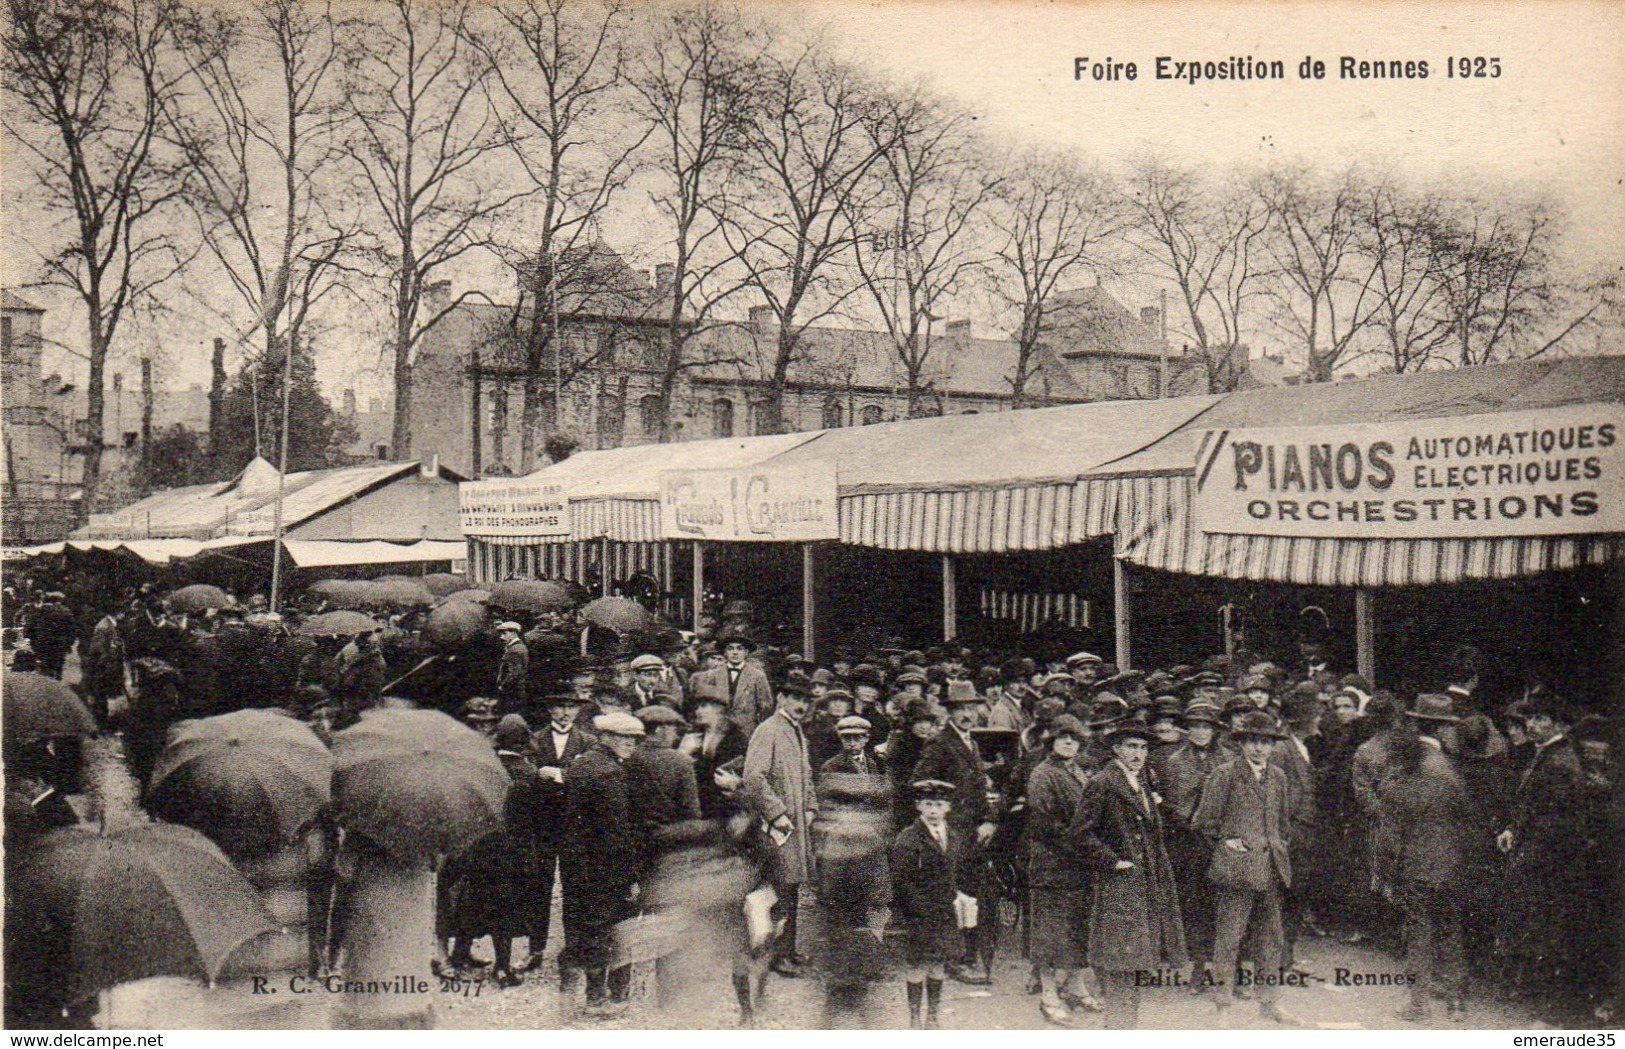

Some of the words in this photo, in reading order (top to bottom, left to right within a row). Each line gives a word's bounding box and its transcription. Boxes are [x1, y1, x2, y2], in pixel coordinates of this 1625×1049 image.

[1231, 441, 1396, 493] PIANOS
[1406, 423, 1616, 461] AUTOMATIQUES
[1414, 457, 1603, 489] ELECTRIQUES
[1247, 491, 1599, 524] ORCHESTRIONS
